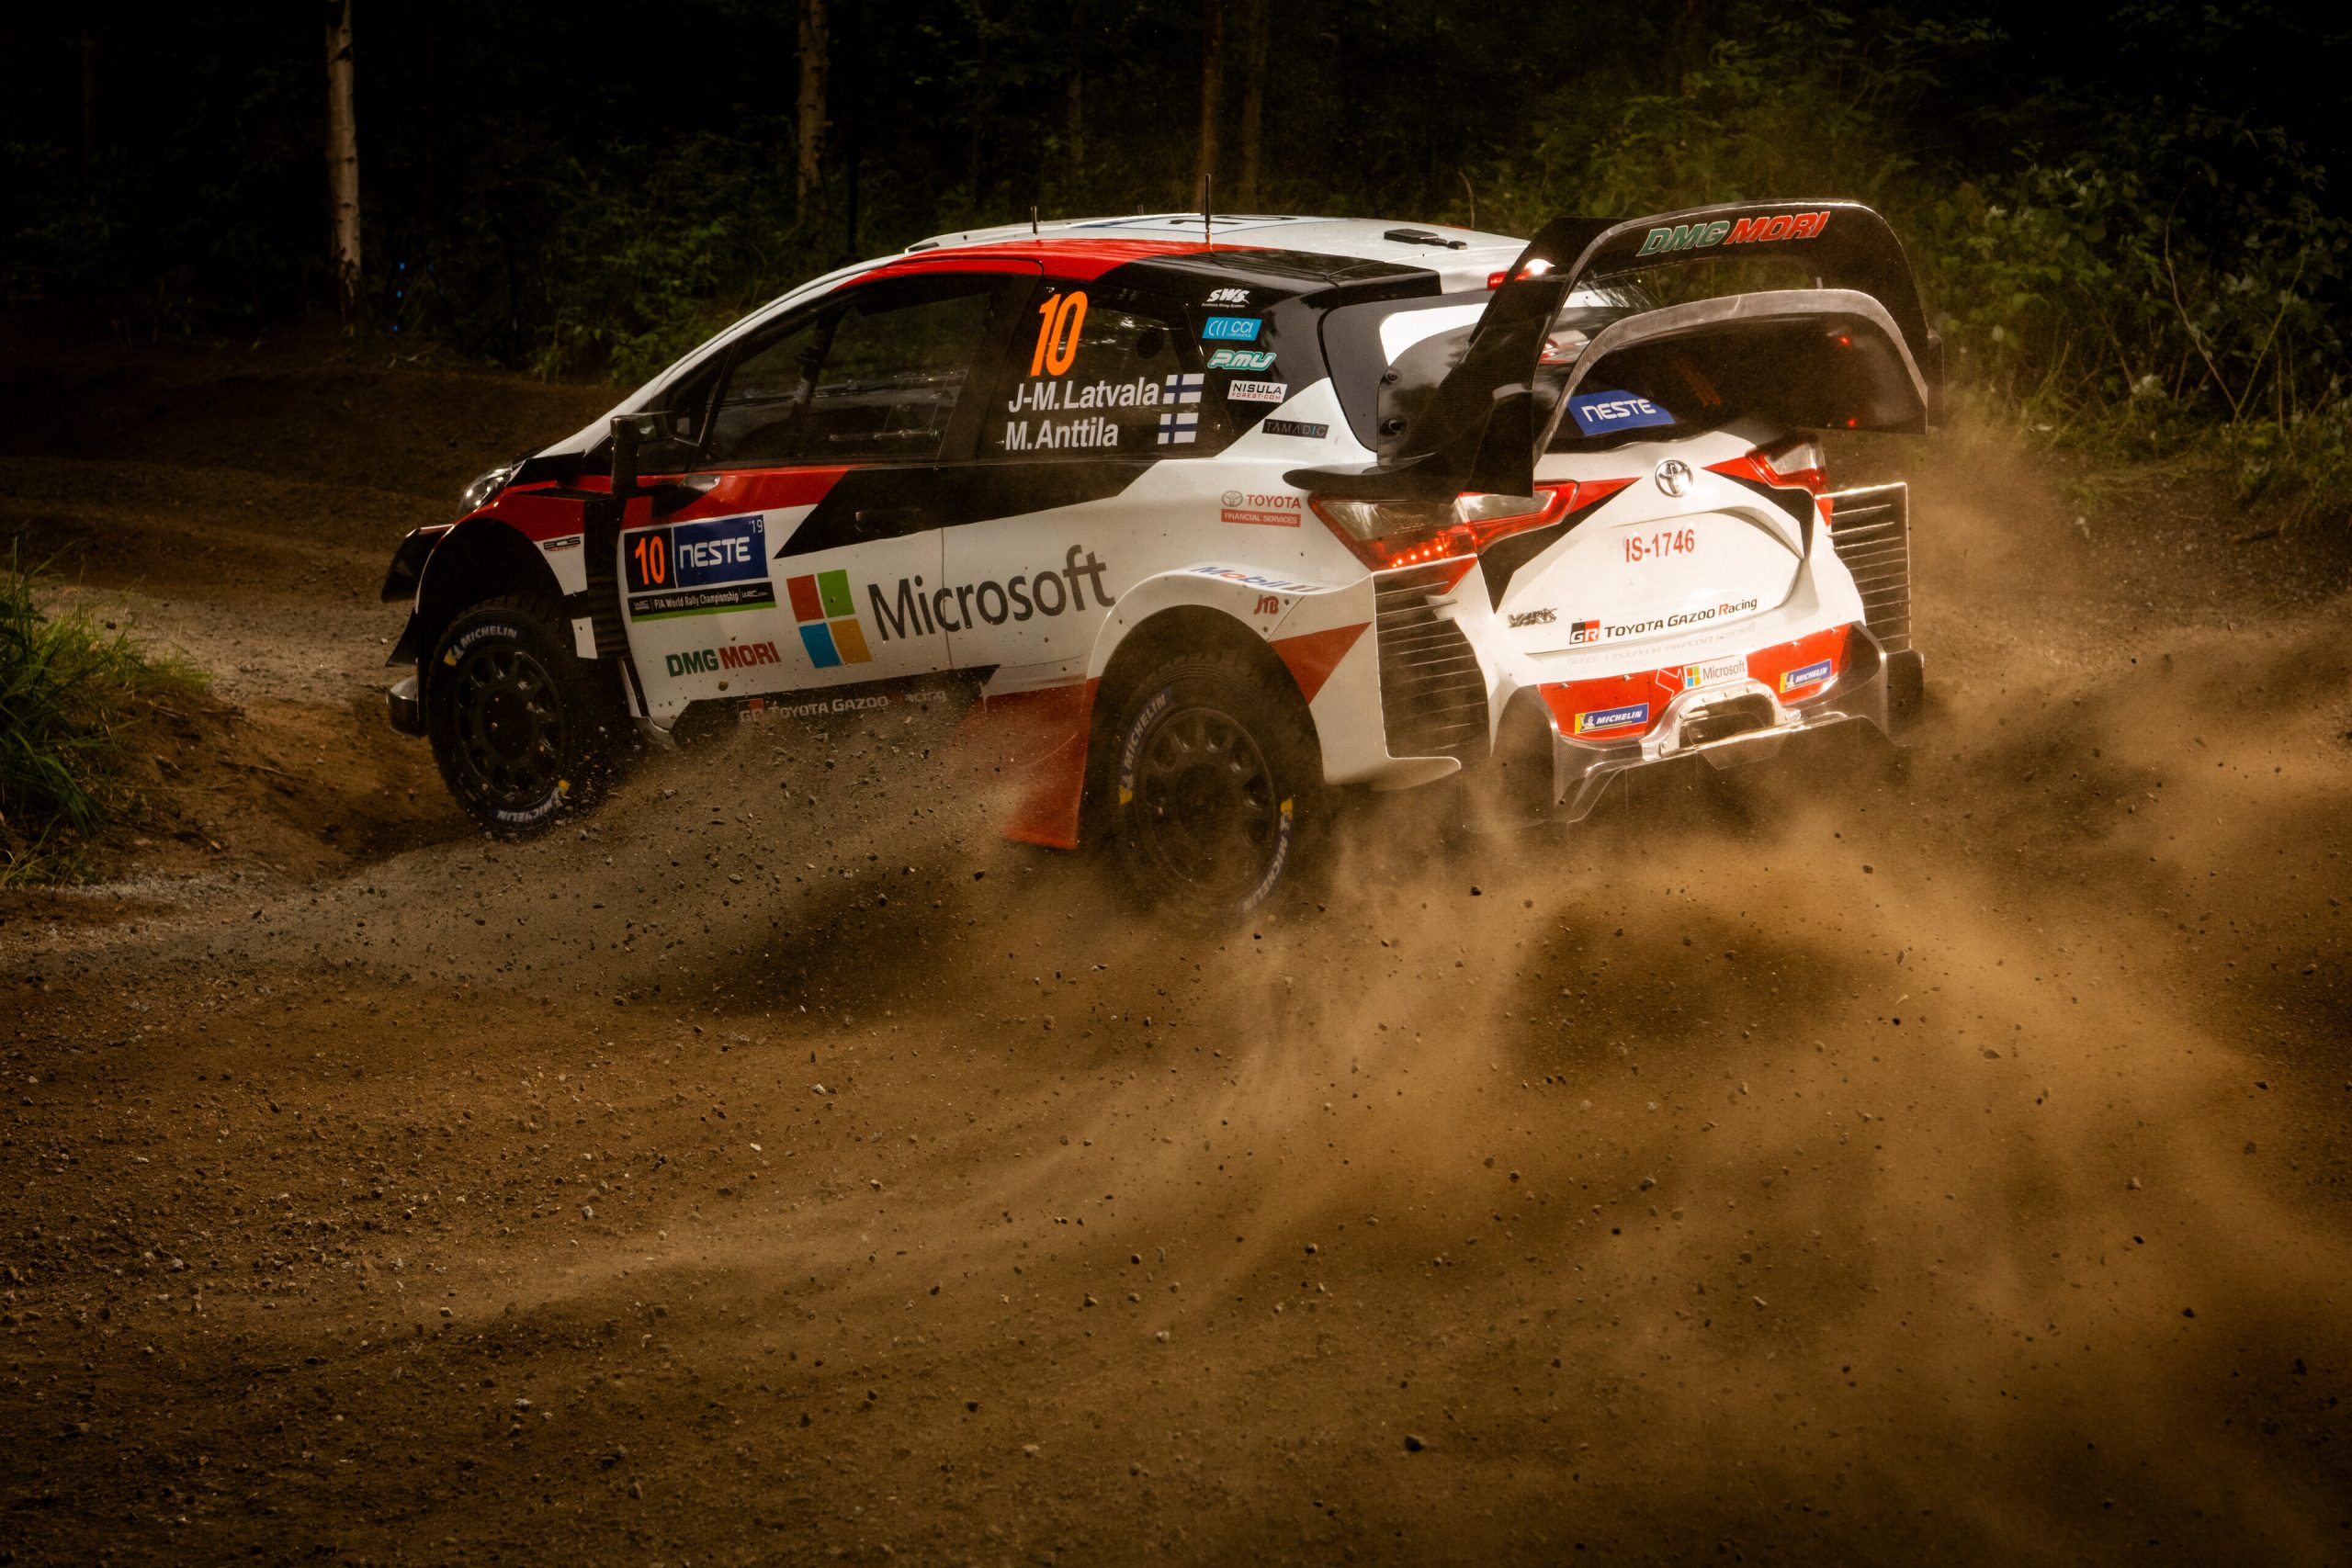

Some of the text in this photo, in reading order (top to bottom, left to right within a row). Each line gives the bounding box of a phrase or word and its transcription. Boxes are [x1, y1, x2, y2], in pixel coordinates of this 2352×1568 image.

[1636, 210, 1831, 256] DMG MORI
[1206, 288, 1250, 304] SWS
[1030, 290, 1088, 377] 10
[1231, 321, 1254, 333] CCI
[1232, 383, 1282, 395] NISULA
[1580, 398, 1657, 423] NESTE
[1267, 423, 1326, 436] TAMADIC
[1247, 494, 1301, 509] TOYOTA
[1225, 512, 1297, 525] FINANCIAL SERVICES
[679, 536, 752, 570] NESTE
[1625, 528, 1696, 563] IS-1746
[635, 536, 666, 585] 10
[653, 591, 740, 610] FIA World Rally Championship
[867, 544, 1115, 642] Microsoft
[1253, 595, 1280, 615] JTB
[1570, 629, 1600, 643] GR
[1604, 619, 1664, 638] TOYOTA
[1668, 608, 1716, 627] GAZOO
[1718, 597, 1758, 617] Racing
[461, 625, 517, 650] MICHELIN
[665, 641, 781, 678] DMG MORI
[1702, 660, 1746, 681] Microsoft
[1794, 666, 1828, 683] MICHELIN
[831, 694, 889, 713] GAZOO
[1596, 710, 1643, 725] MICHELIN
[1123, 693, 1167, 772] MICHELIN
